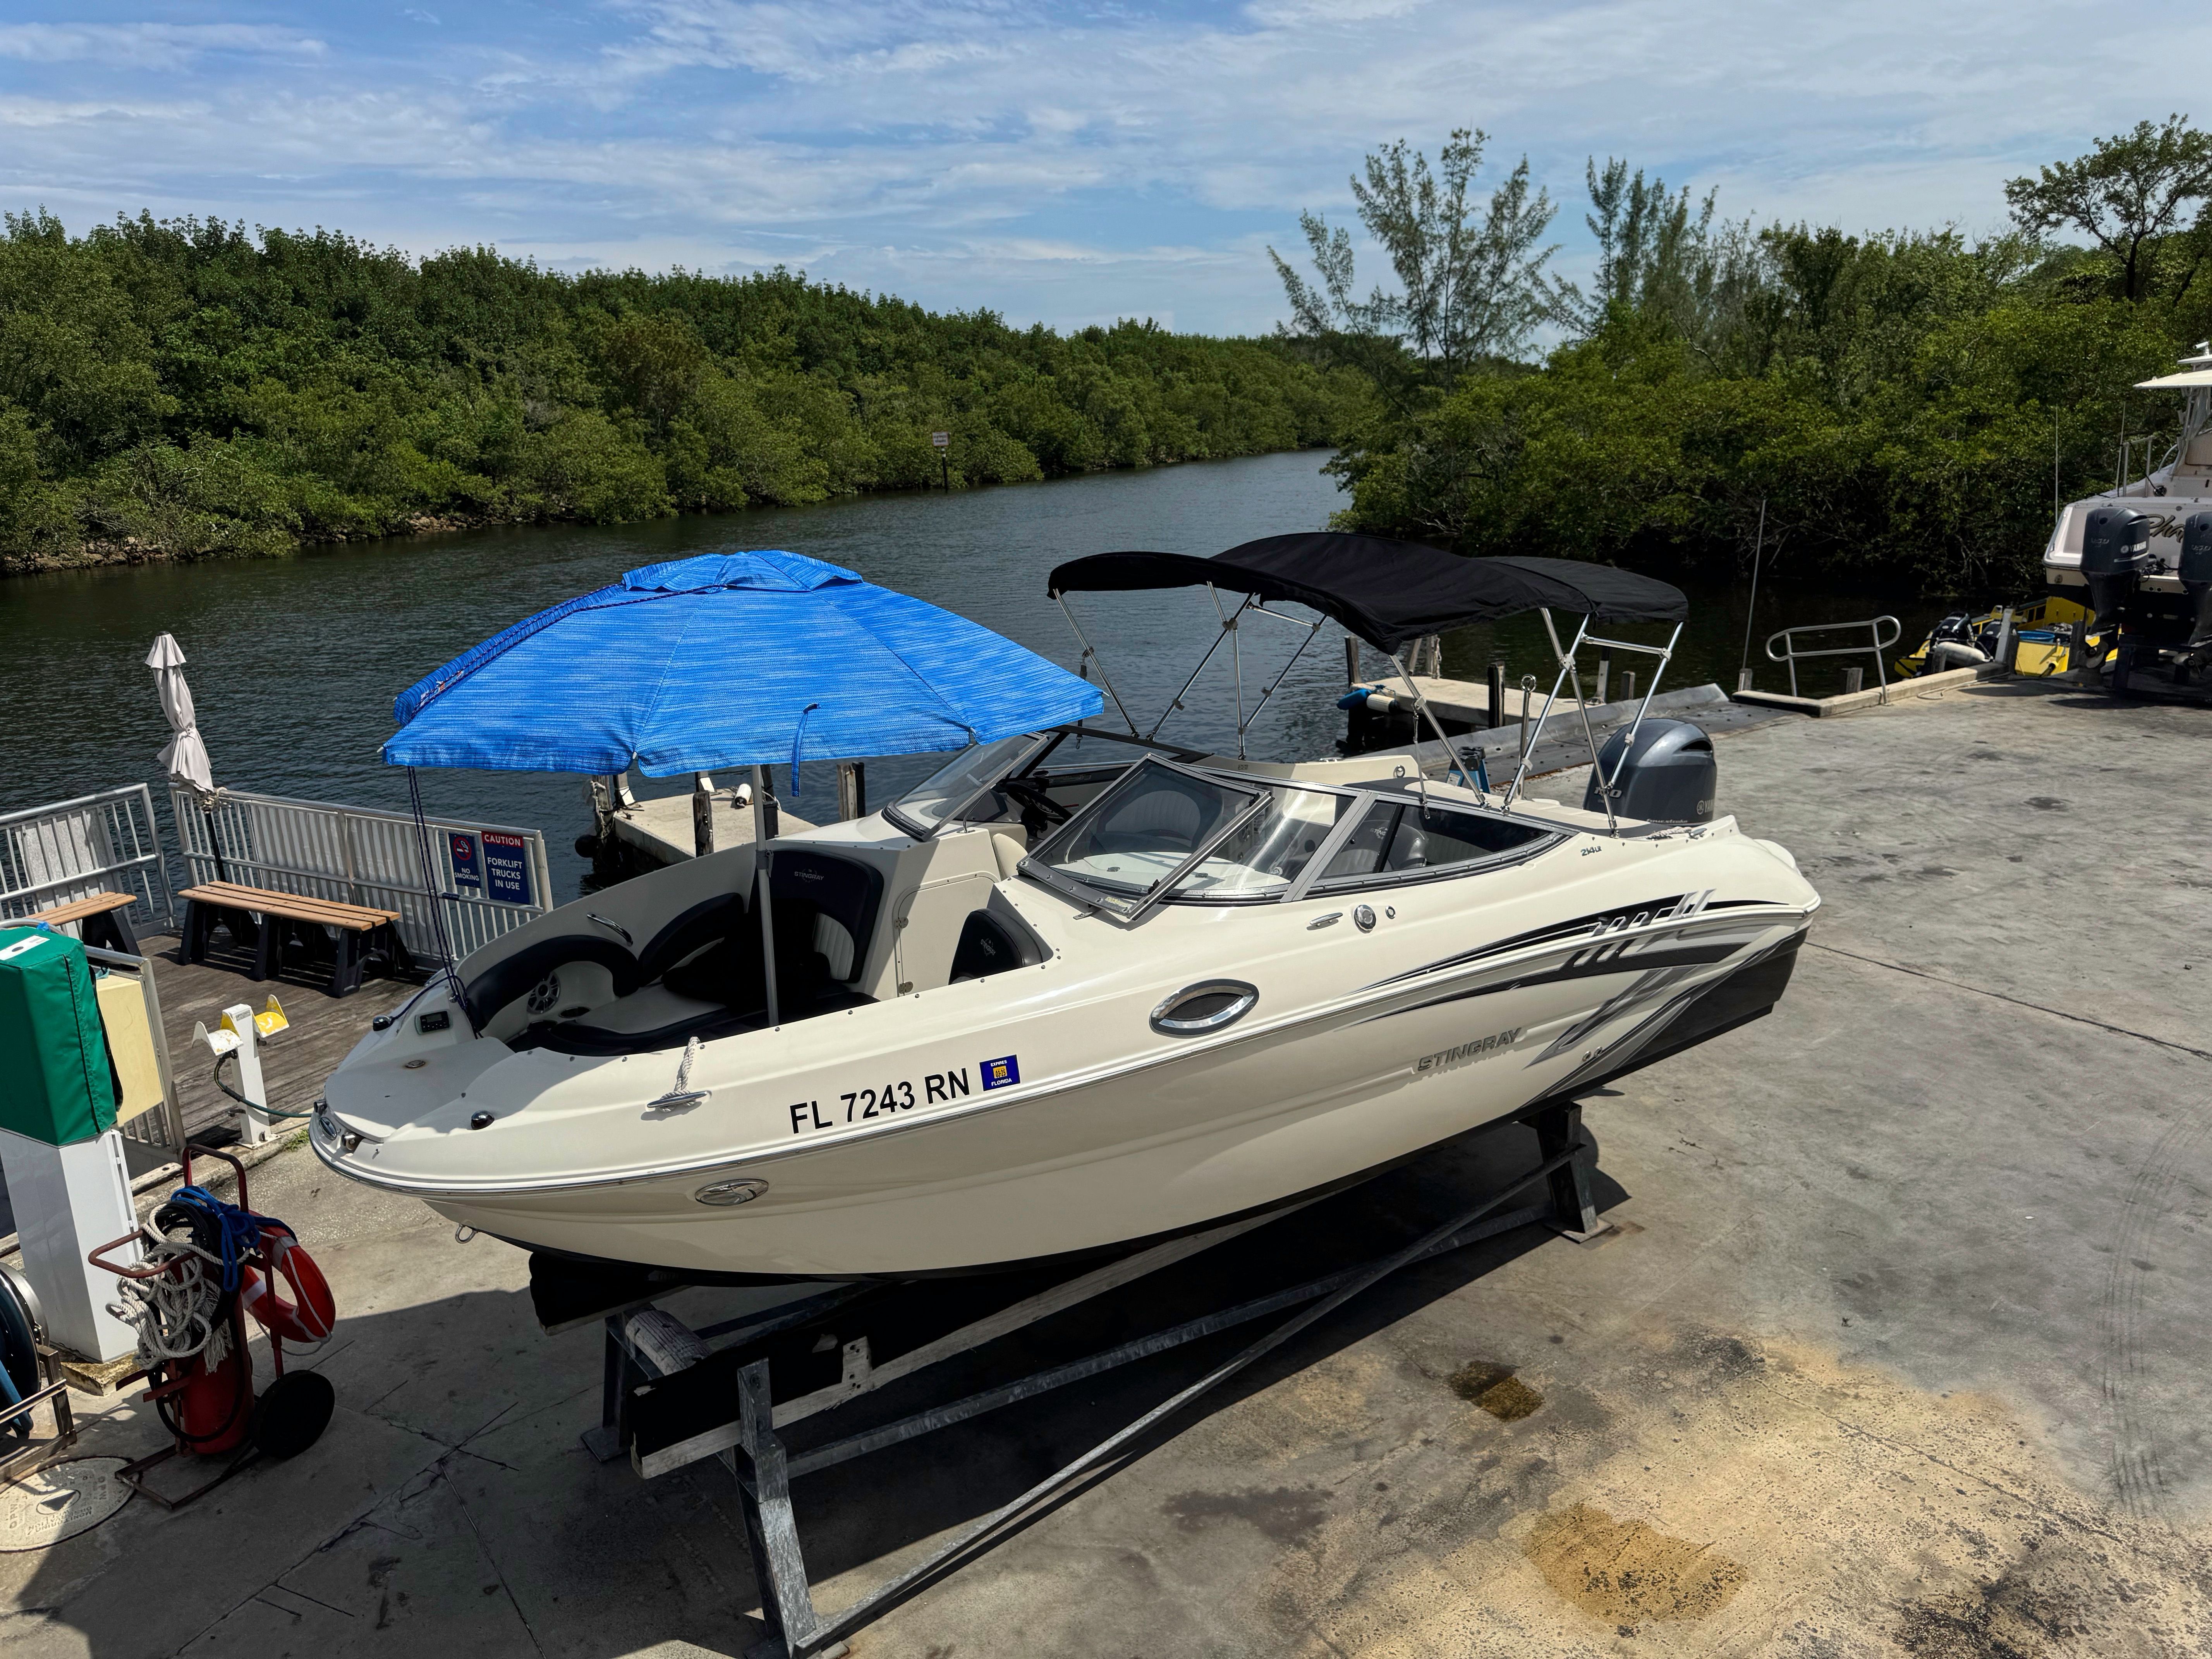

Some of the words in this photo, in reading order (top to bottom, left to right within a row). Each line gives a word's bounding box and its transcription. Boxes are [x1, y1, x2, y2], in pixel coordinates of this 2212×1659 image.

[484, 834, 520, 846] CAUTION
[487, 857, 522, 869] FORKLIFT
[454, 872, 479, 881] SMOKING
[491, 868, 520, 879] TRUCKS
[794, 871, 824, 880] STINGRAY
[495, 879, 503, 888] IN
[505, 881, 520, 890] USE
[1418, 1027, 1522, 1072] STINGRAY
[991, 1078, 1012, 1086] FLORIDA
[790, 1100, 833, 1134] FL
[840, 1081, 915, 1123] 7243
[925, 1068, 970, 1104] RN
[9, 1502, 18, 1529] OPW
